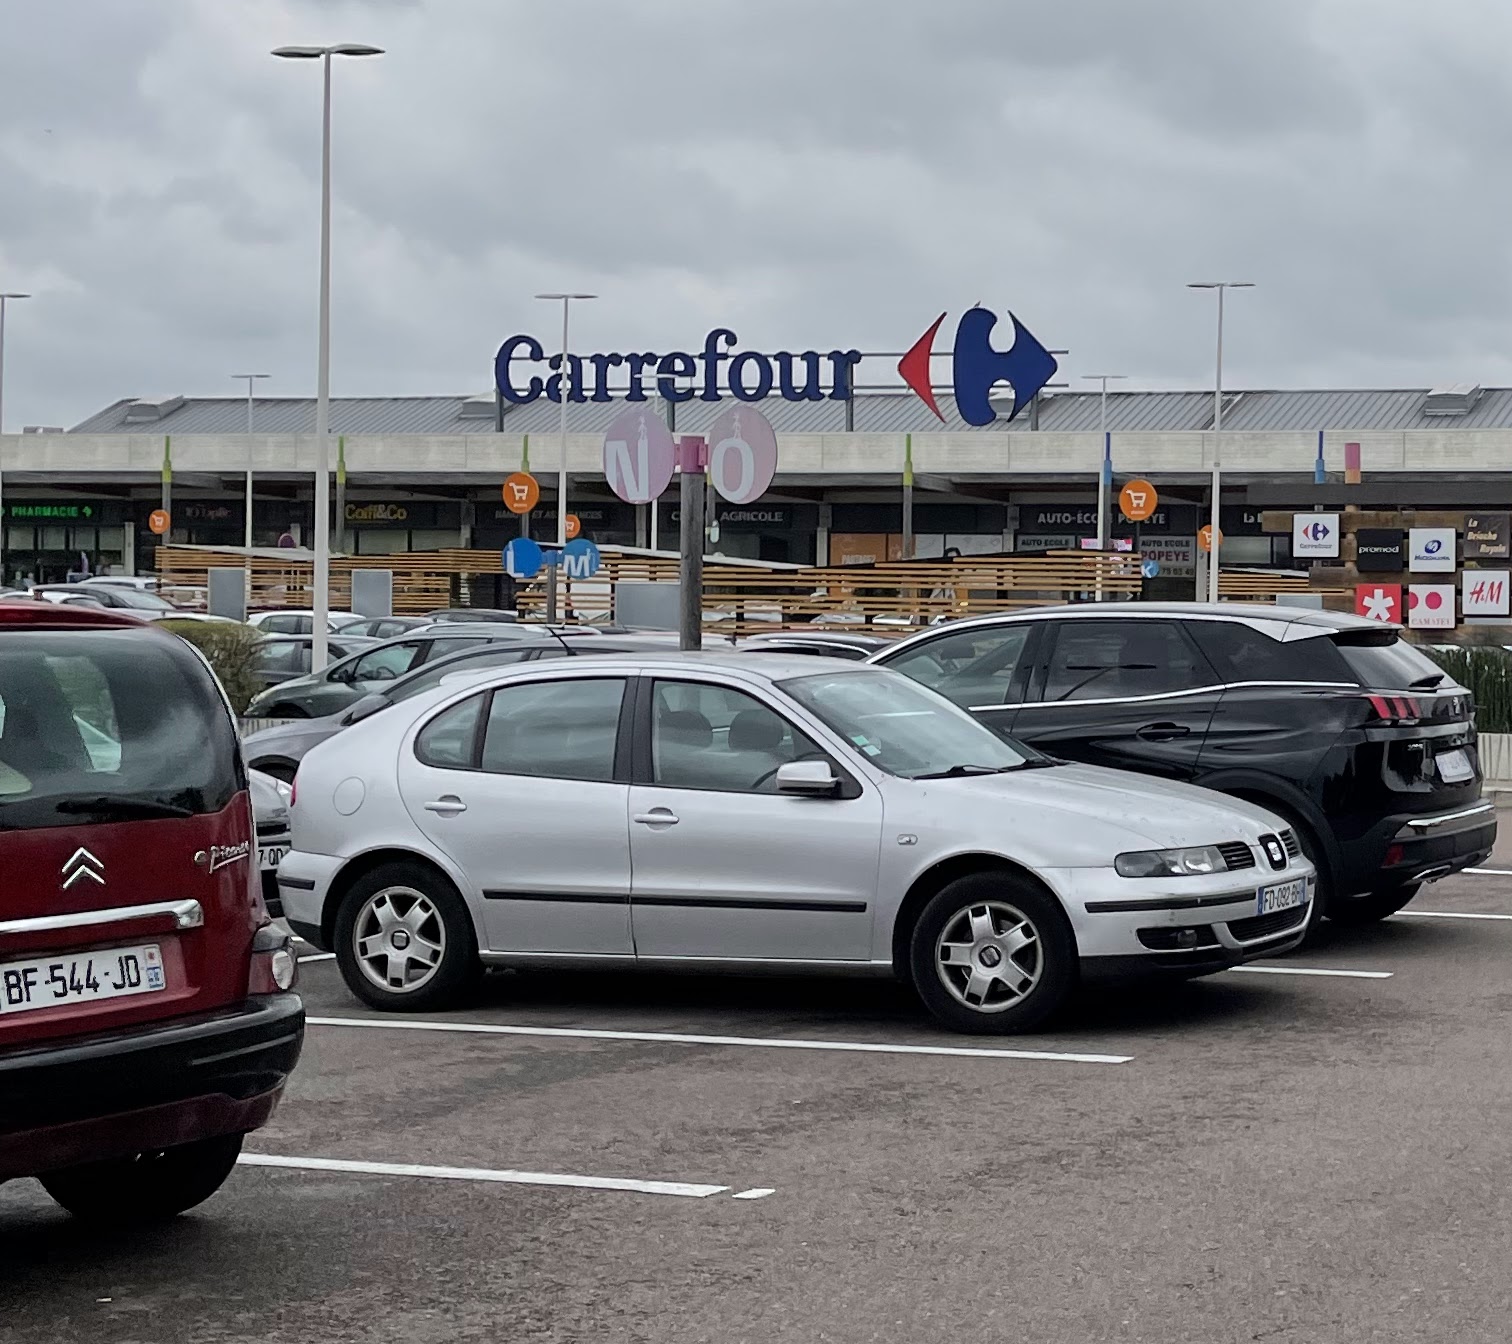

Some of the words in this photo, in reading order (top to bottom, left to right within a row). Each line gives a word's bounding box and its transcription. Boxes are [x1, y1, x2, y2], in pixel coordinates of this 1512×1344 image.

[495, 328, 862, 404] Carrefour
[606, 439, 649, 501] N
[11, 506, 78, 517] PHARMACIE
[720, 511, 783, 522] AGRICOLE
[1037, 510, 1112, 524] AUTO-ÉCO
[1118, 513, 1166, 524] POEYE
[1022, 539, 1042, 547] AUTO
[1141, 540, 1162, 548] AUTO
[1164, 540, 1190, 548] ECOLE
[1359, 545, 1400, 554] promod
[1140, 551, 1190, 562] POPEYE
[1468, 580, 1503, 605] H&M
[3, 954, 142, 1005] BF-544-JD
